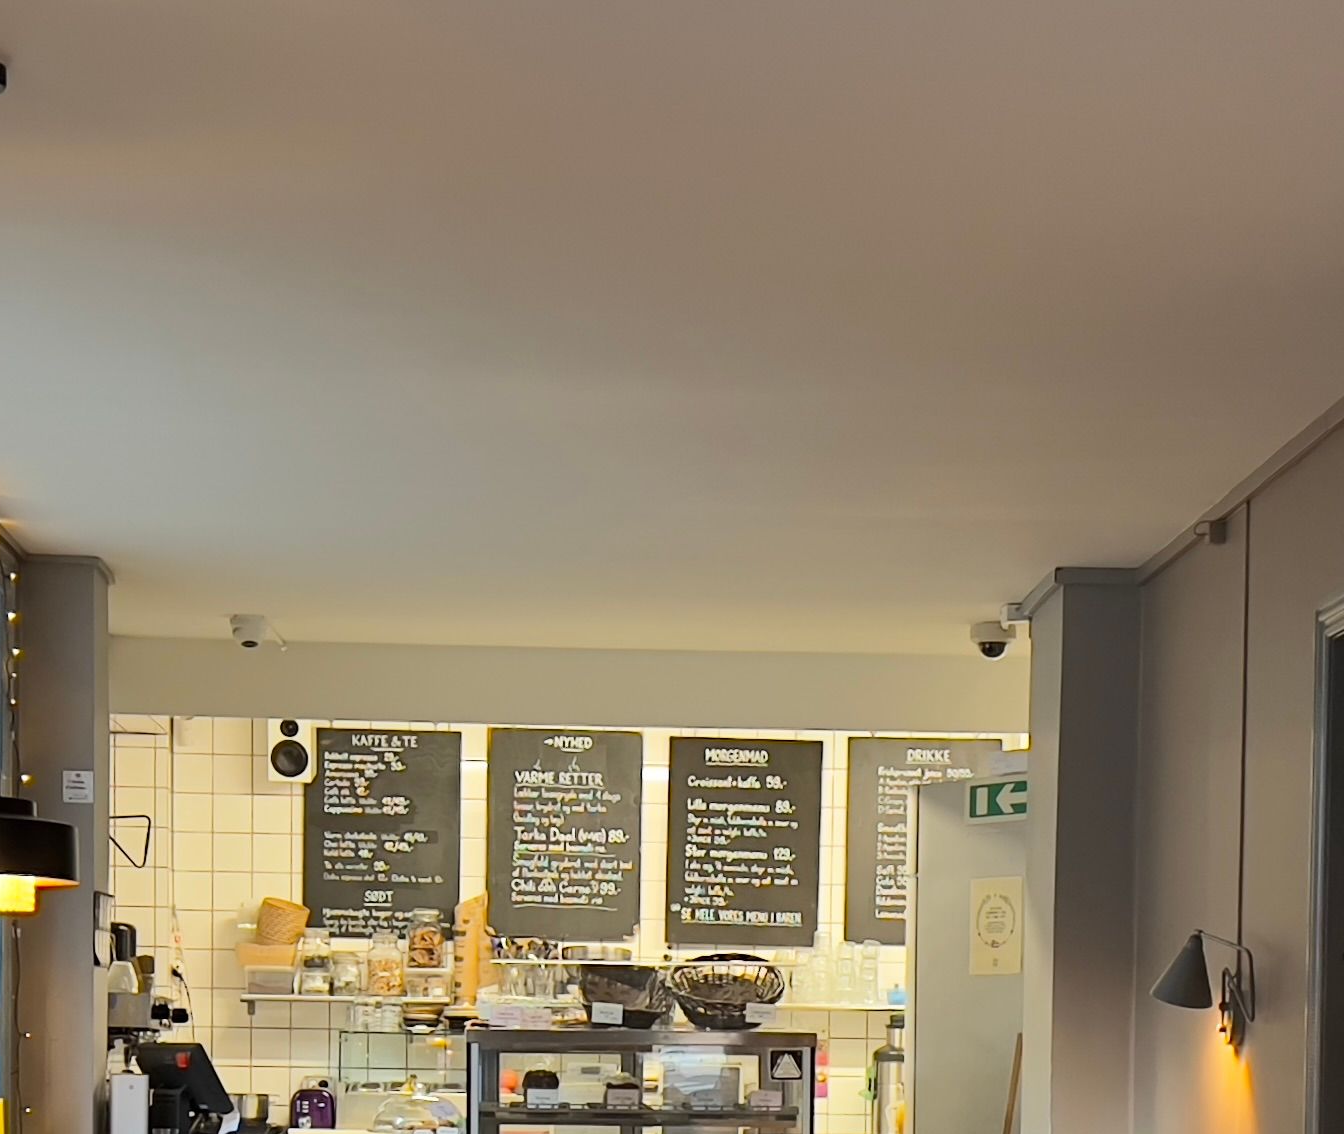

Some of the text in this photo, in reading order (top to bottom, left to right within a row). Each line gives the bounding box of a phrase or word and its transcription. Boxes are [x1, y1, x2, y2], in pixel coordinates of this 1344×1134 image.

[351, 734, 418, 748] KAFFE & TE
[554, 736, 593, 750] NYHED
[705, 748, 769, 764] MORGENMAD
[906, 748, 951, 762] DRIKKE
[514, 770, 604, 786] VARME RETTER
[363, 890, 394, 903] SØDT
